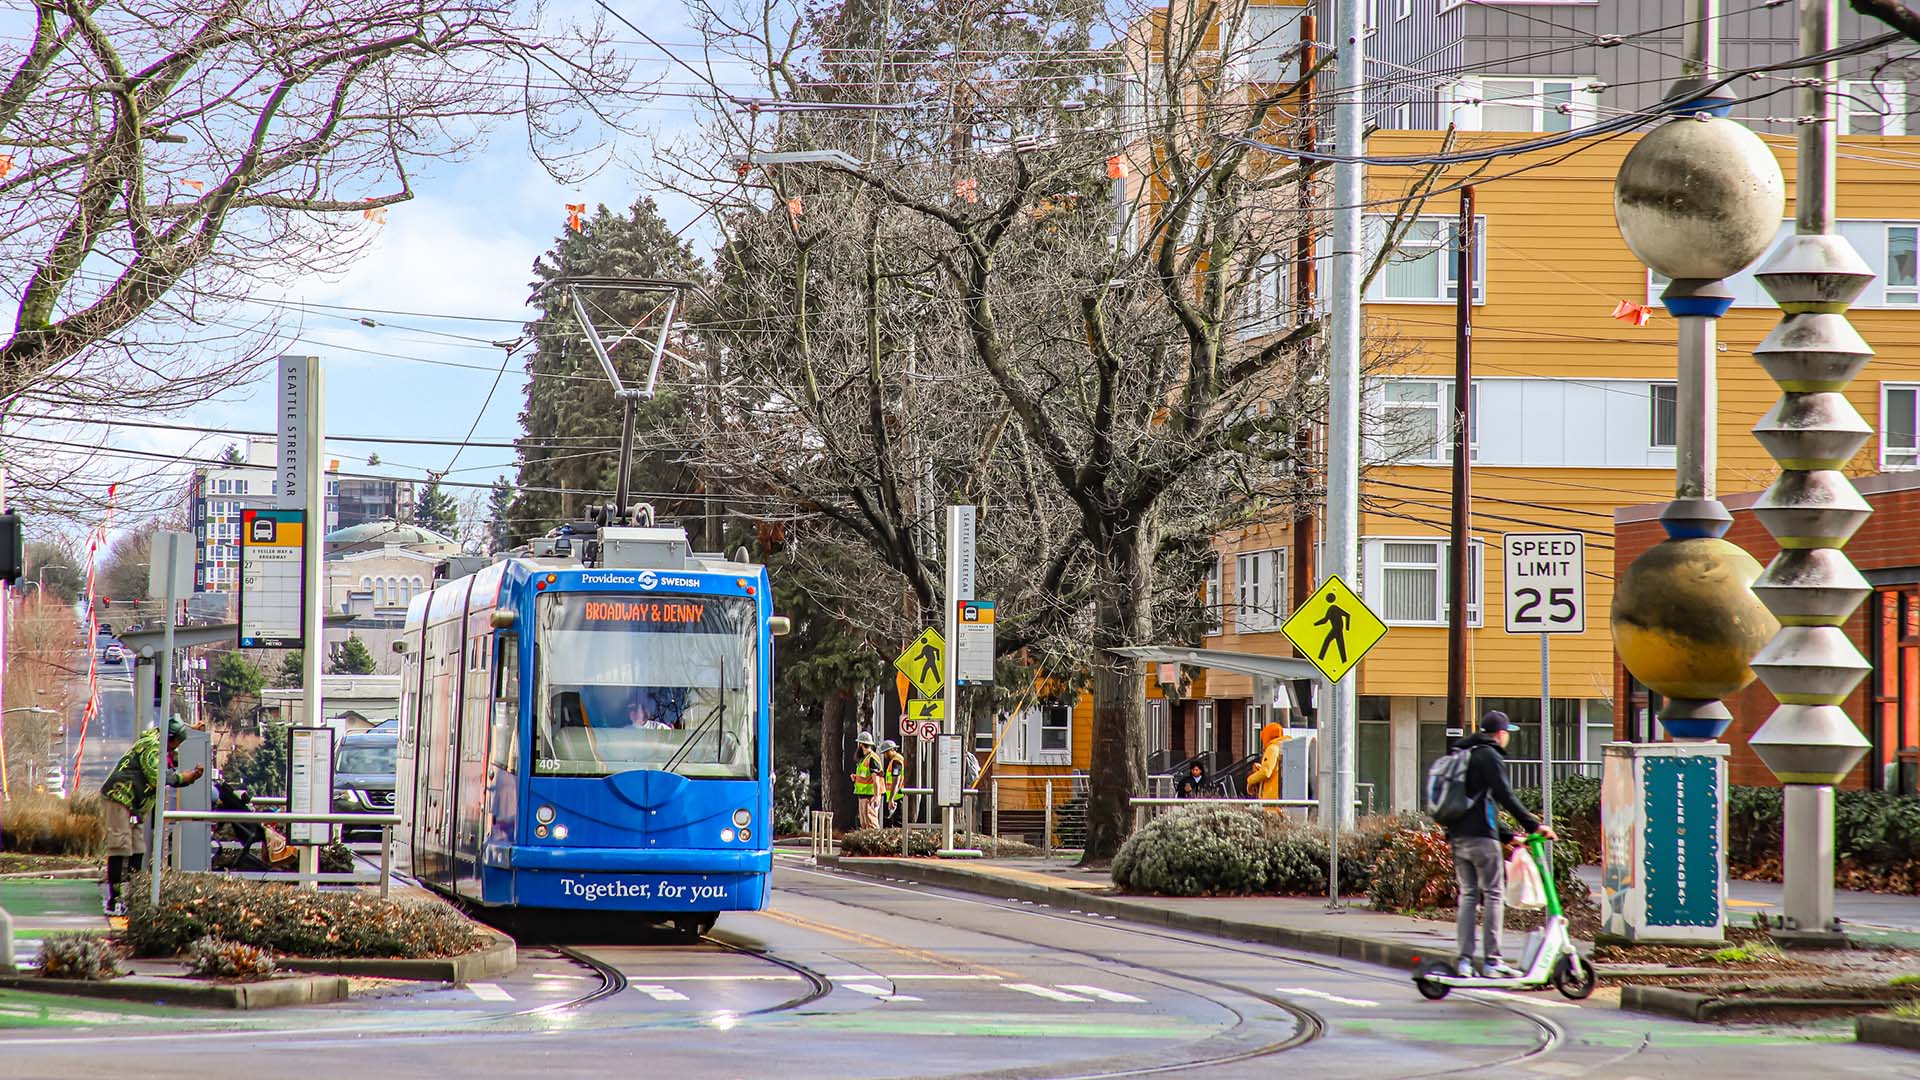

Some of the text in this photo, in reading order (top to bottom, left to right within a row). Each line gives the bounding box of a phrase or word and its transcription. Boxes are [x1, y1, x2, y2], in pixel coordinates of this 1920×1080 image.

[286, 367, 297, 496] SEATTLE STREETCAR
[962, 512, 970, 593] SEATTLE STREETCAR
[1512, 541, 1576, 556] SPEED
[582, 573, 700, 588] Providence SWEDISH
[1518, 562, 1570, 576] LIMIT
[585, 602, 704, 622] BROADWAY & DENNY
[1514, 588, 1576, 623] 25
[538, 759, 561, 769] 405
[1676, 773, 1685, 824] YESLER
[1677, 839, 1686, 906] BROADWAY
[560, 879, 728, 902] Together, for you.
